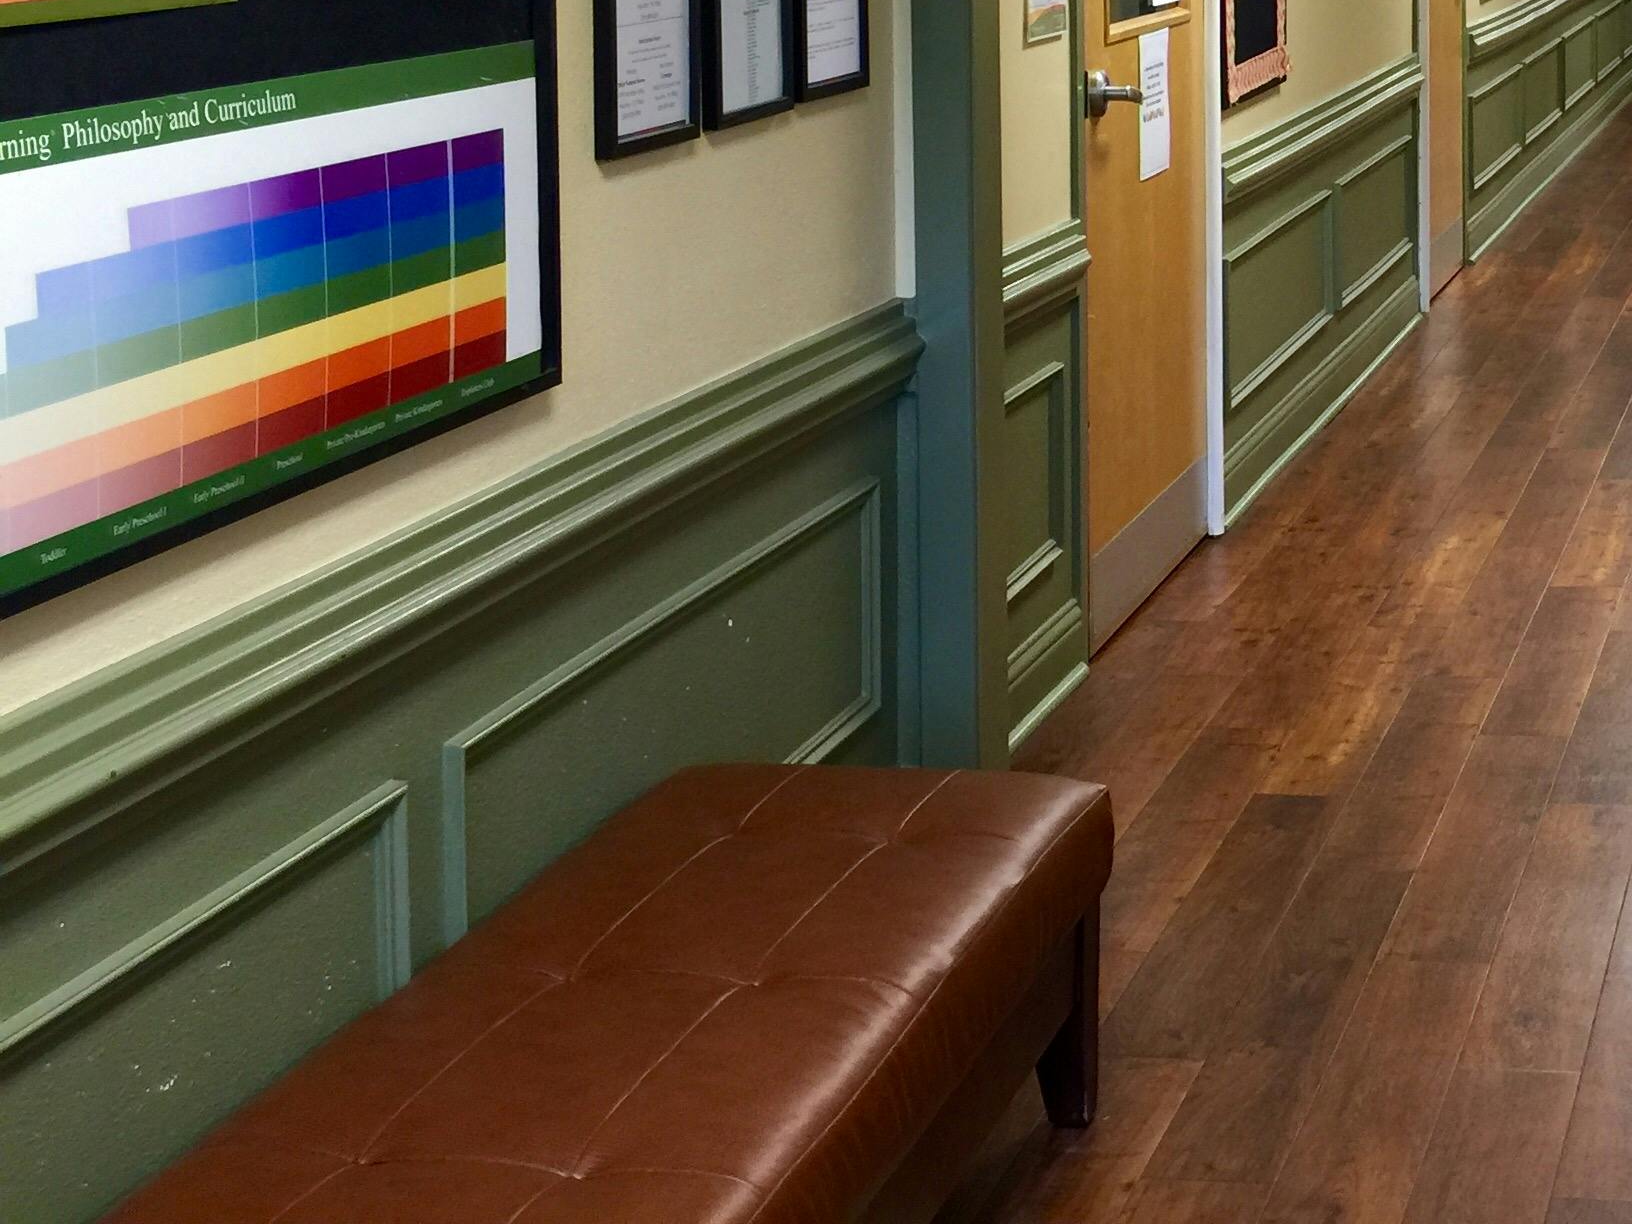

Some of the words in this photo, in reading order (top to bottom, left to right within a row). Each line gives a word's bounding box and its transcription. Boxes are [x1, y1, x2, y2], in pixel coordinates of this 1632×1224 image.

[61, 109, 163, 150] Philosophy
[169, 101, 200, 131] and
[204, 89, 297, 124] Curriculum
[113, 517, 131, 536] Early
